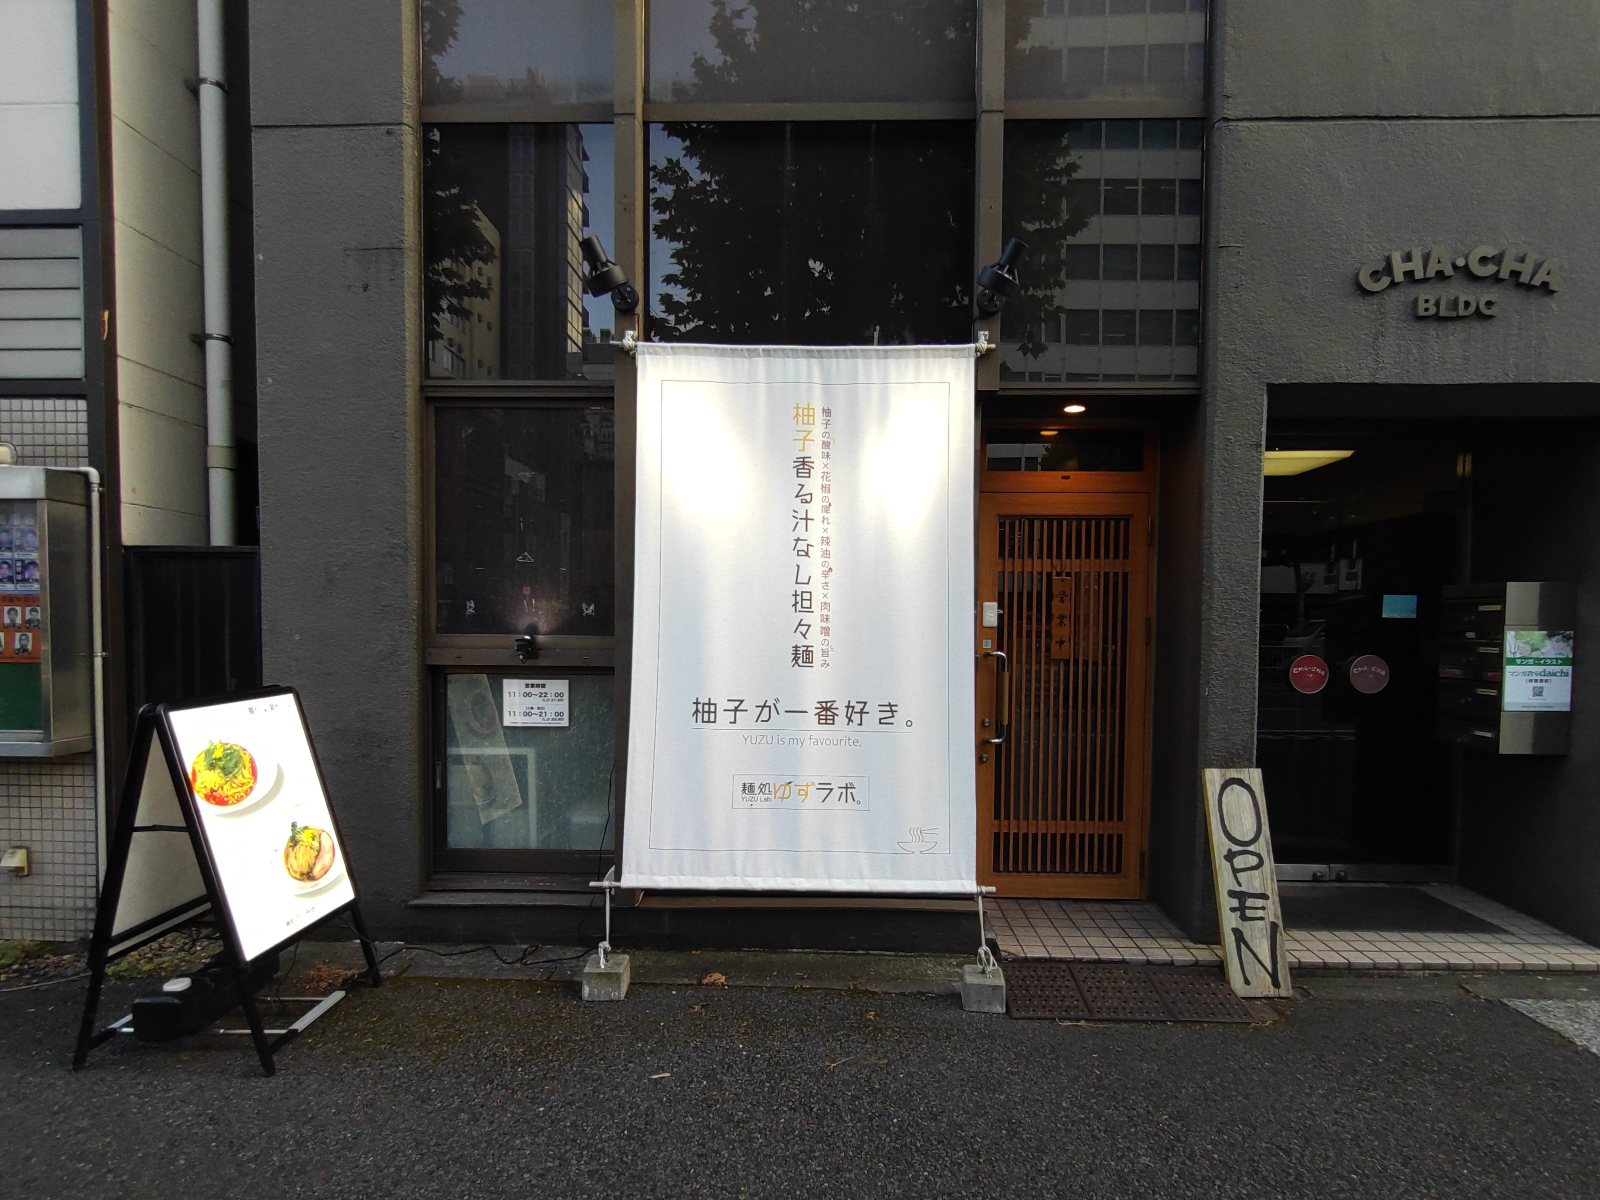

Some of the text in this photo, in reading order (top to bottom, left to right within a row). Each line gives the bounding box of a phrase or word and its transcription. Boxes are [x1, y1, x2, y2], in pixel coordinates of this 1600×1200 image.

[791, 402, 816, 669] 柚子香る汁なし担々麺
[1055, 591, 1068, 651] 営業中
[691, 697, 914, 728] 柚子が一番好き。
[742, 734, 862, 748] YUZU is my favourite.
[1217, 776, 1281, 990] OPEN
